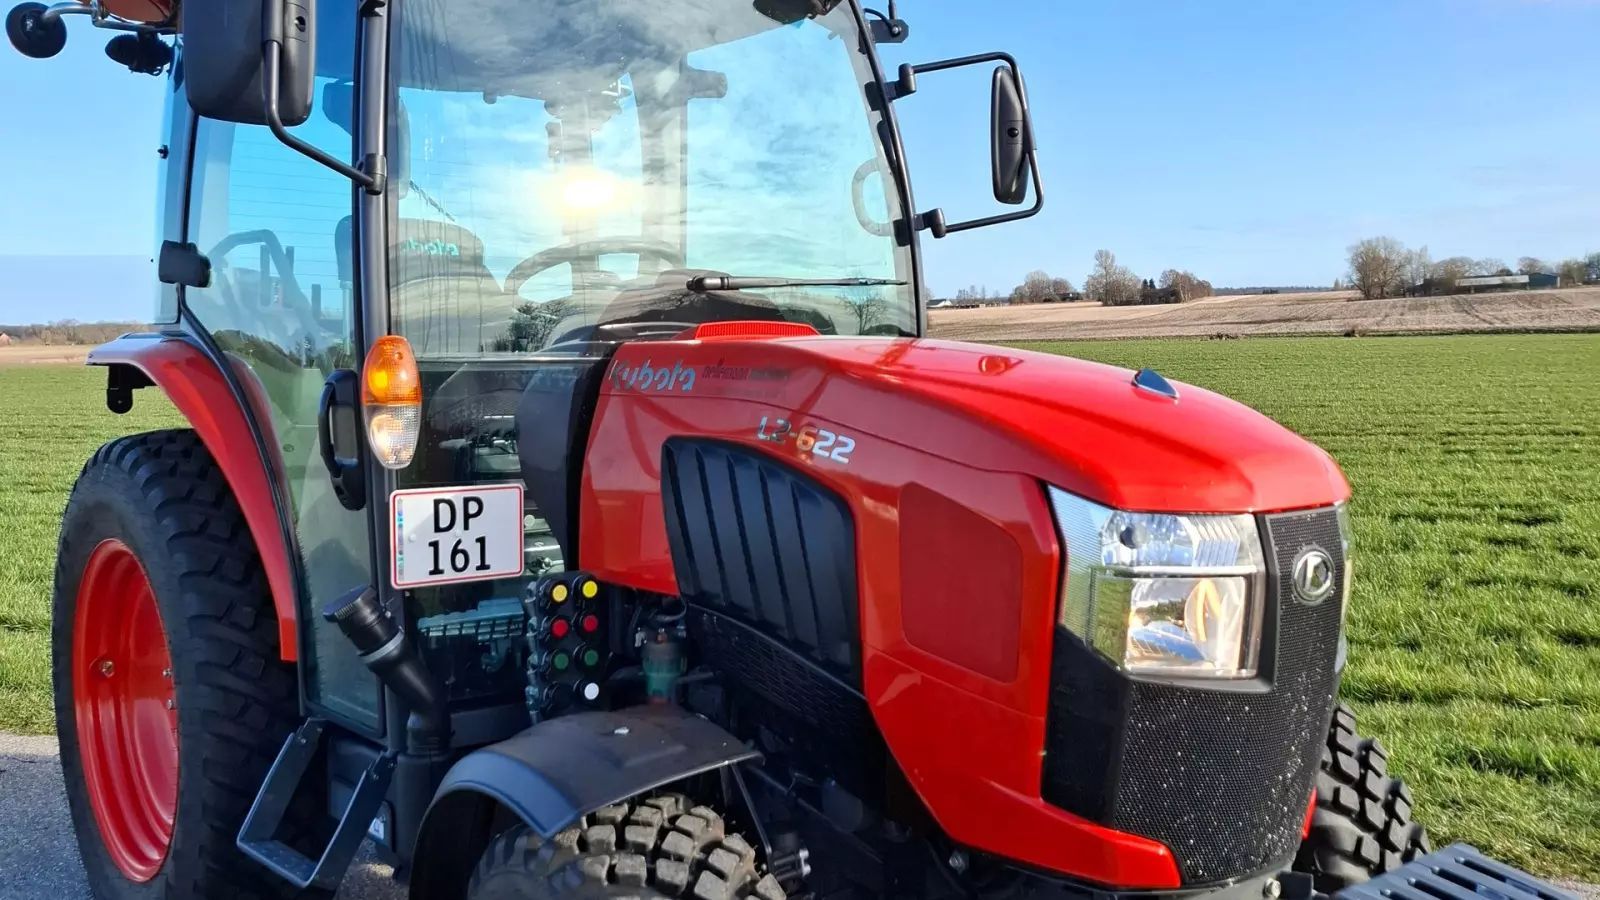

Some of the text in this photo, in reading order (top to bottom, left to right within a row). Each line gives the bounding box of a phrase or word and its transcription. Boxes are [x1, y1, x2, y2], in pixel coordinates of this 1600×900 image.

[608, 359, 696, 391] Kubota
[758, 416, 856, 464] L2-622
[433, 496, 484, 533] DP
[428, 535, 491, 576] 161
